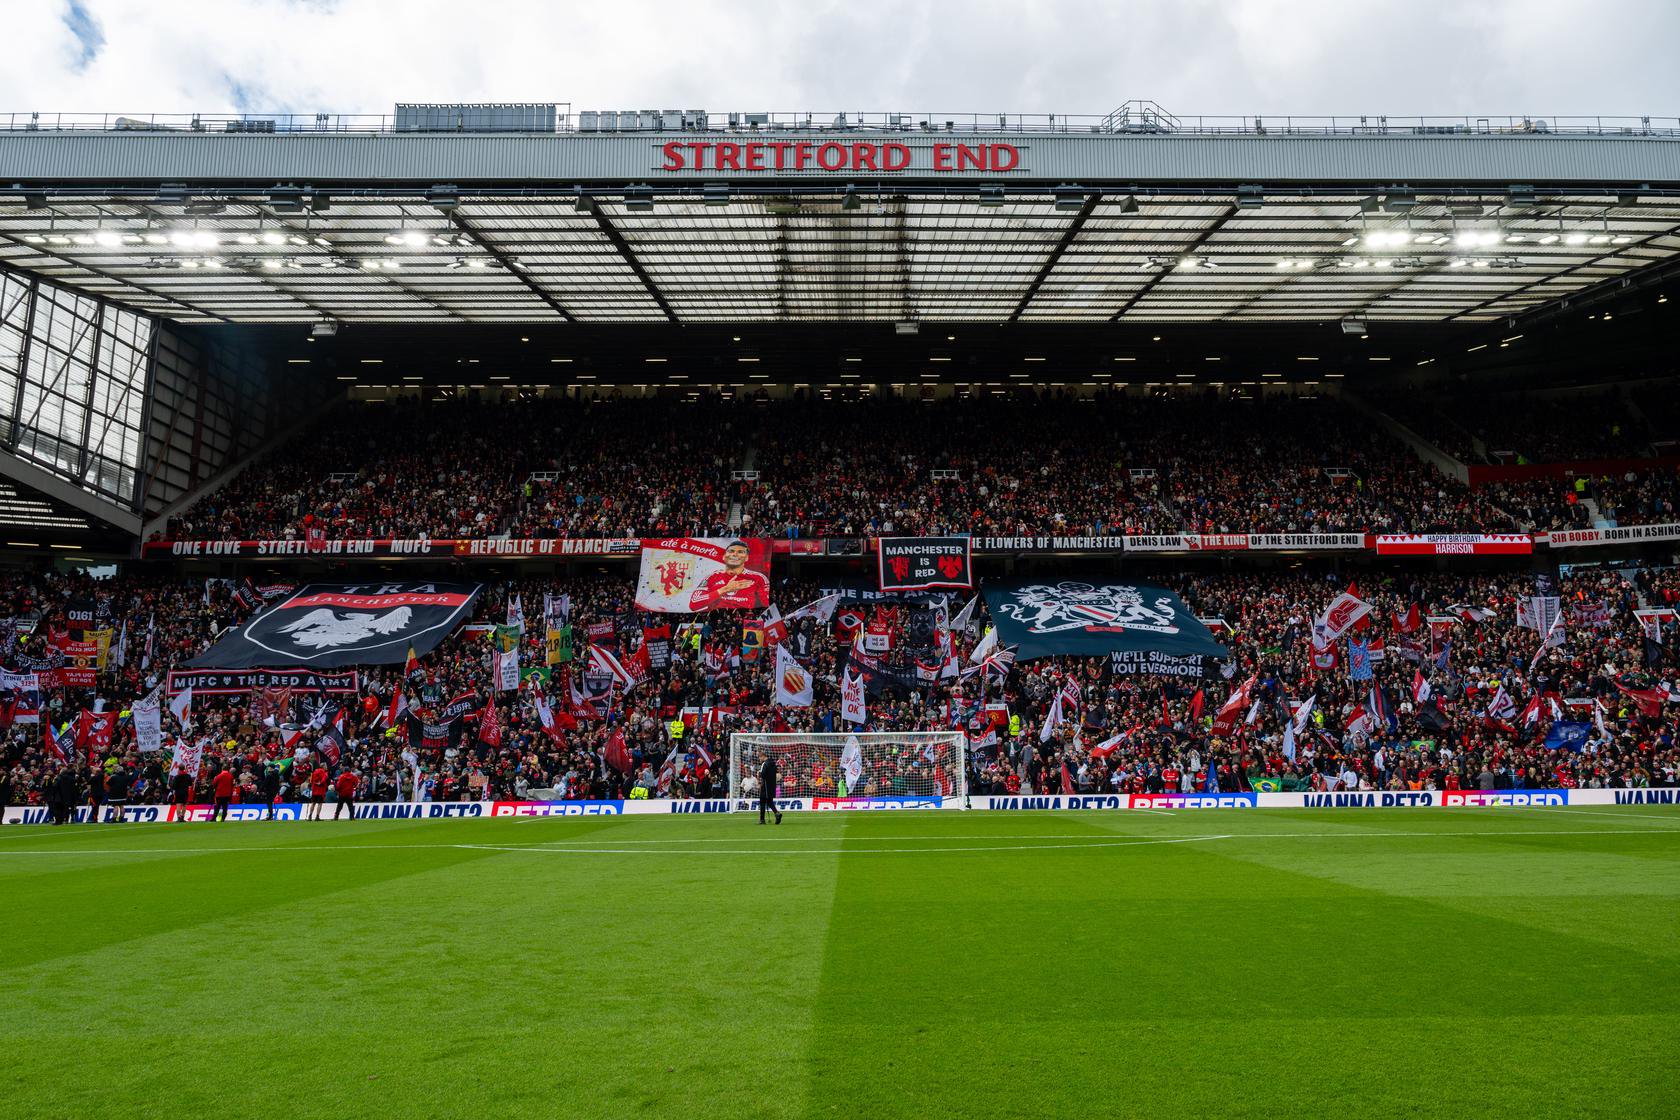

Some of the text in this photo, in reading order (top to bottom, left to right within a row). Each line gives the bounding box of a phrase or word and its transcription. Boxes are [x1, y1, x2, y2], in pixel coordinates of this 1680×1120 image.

[662, 141, 1019, 171] STRETFORD END
[1130, 536, 1181, 546] DENIS LAW
[1204, 535, 1246, 546] THE KING
[1251, 535, 1358, 546] OF THE STRETFORD END
[1427, 535, 1481, 543] HAPPY BIRTHDAY!
[1552, 533, 1567, 543] SIR
[1605, 529, 1630, 539] BORN
[1633, 528, 1642, 538] IN
[172, 541, 241, 555] ONE LOVE
[346, 540, 375, 553] END
[390, 540, 432, 553] MUFC
[539, 539, 556, 553] OF
[660, 538, 718, 557] até à morte
[985, 537, 1033, 549] FLOWERS
[1037, 537, 1049, 549] OF
[1053, 537, 1121, 549] MANCHESTER
[1436, 543, 1474, 554] HARRISON
[885, 546, 963, 556] MANCHESTER
[919, 557, 930, 567] IS
[914, 568, 936, 578] RED
[341, 584, 437, 595] TRA
[68, 610, 92, 620] 0161
[1111, 651, 1202, 665] WE'LL SUPPORT
[1111, 663, 1203, 677] YOU EVERMORE
[174, 674, 350, 688] MUFC THE RED ARMY
[989, 797, 1061, 809] WANNA
[1304, 794, 1375, 807] WANNA
